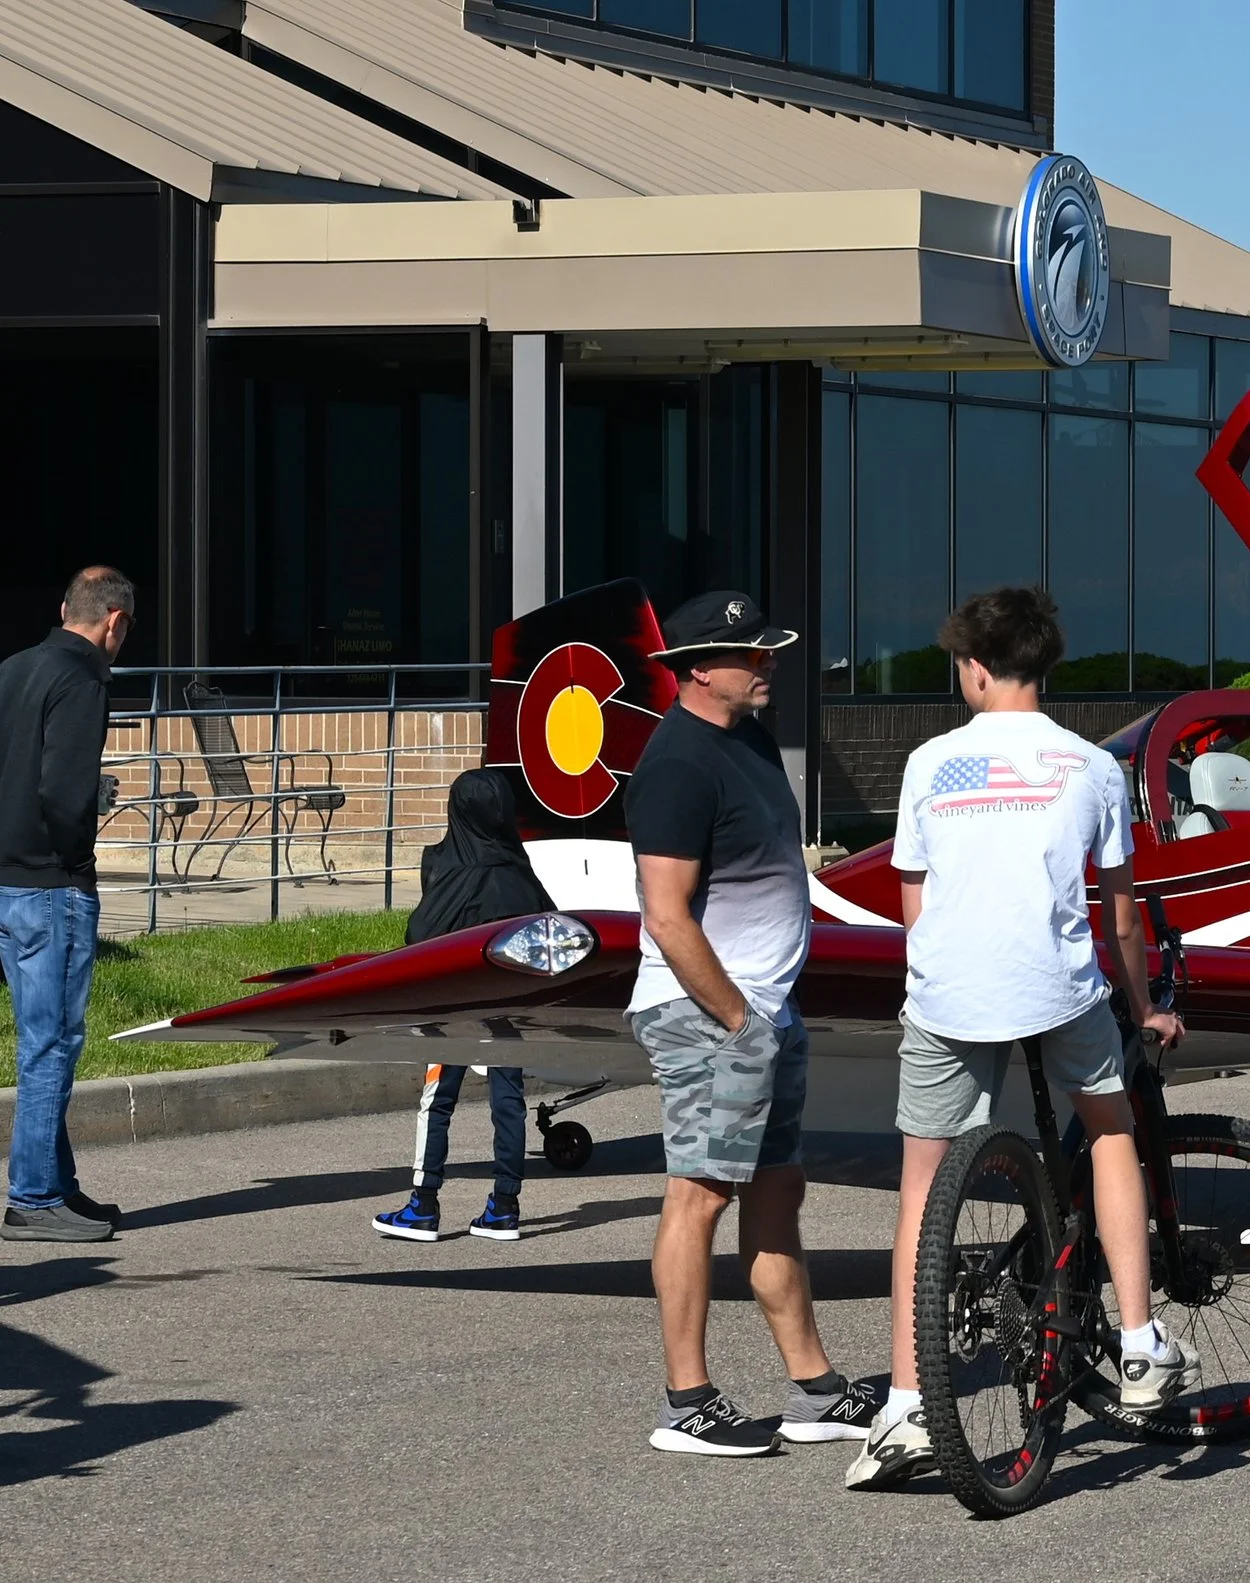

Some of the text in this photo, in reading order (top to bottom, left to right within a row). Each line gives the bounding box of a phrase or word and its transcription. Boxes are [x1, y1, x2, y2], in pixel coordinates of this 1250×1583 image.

[1036, 164, 1108, 272] COLORADO AIR AND
[1041, 302, 1101, 360] SPACE PORT
[937, 800, 1047, 819] vineyard vines
[1103, 1402, 1206, 1437] BONTRAGER
